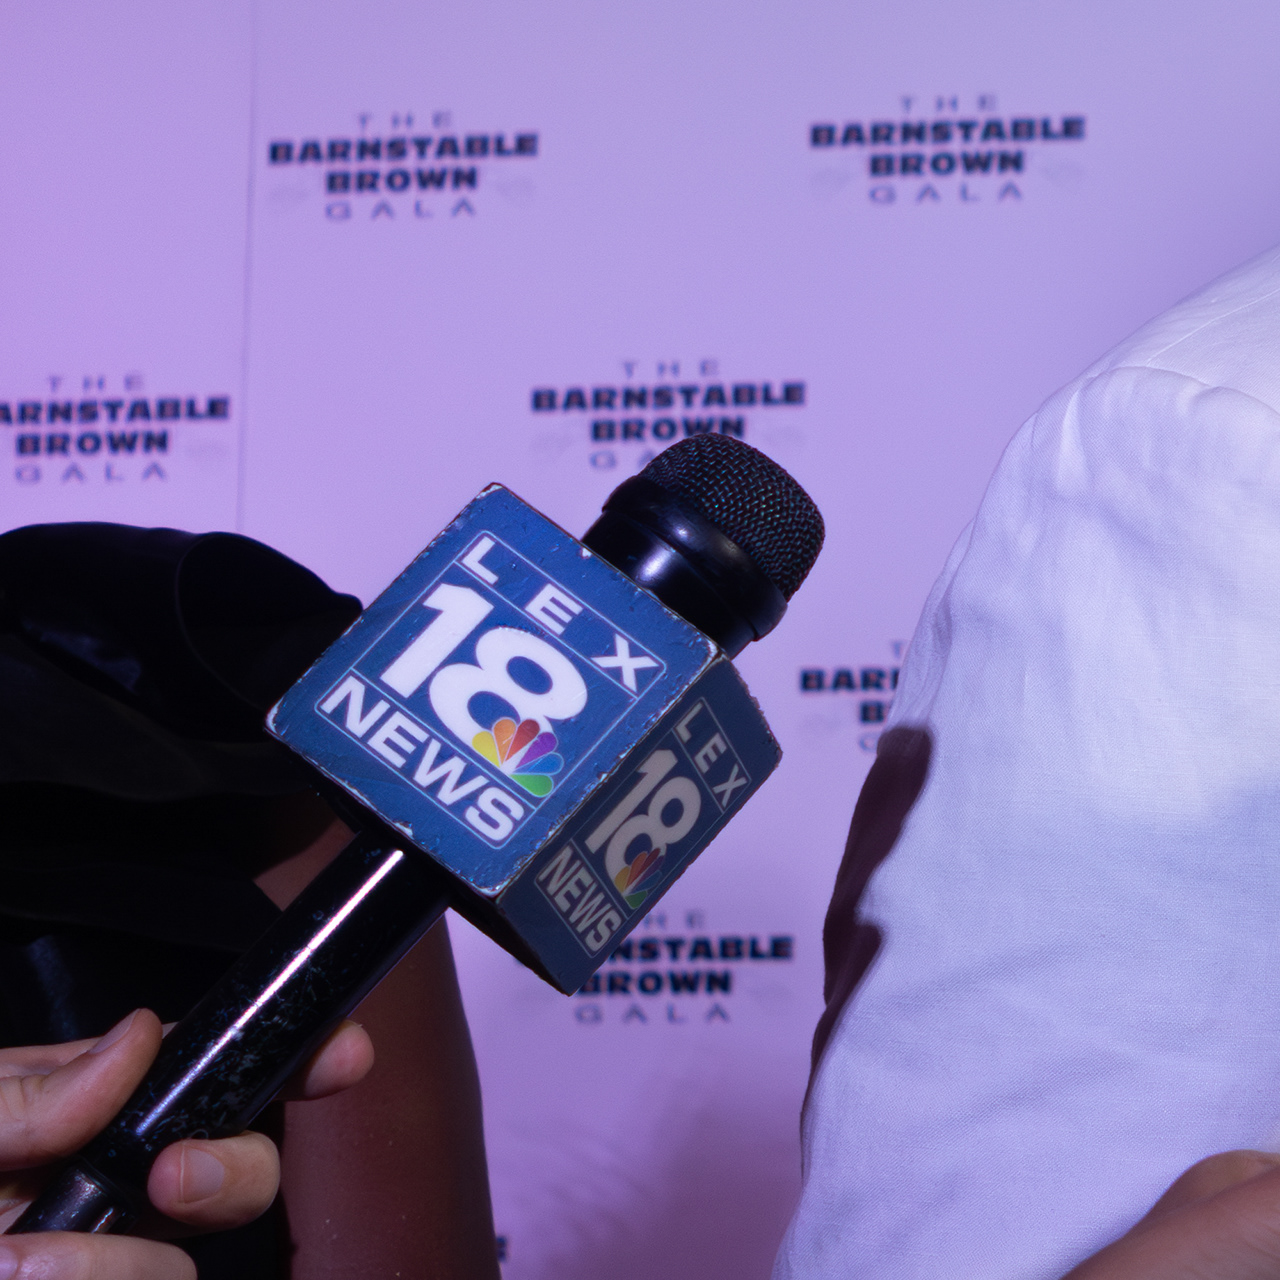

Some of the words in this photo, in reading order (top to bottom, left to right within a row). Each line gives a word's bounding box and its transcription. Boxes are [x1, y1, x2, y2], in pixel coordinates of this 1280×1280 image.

[900, 93, 996, 112] THE
[357, 111, 451, 130] THE
[809, 115, 1086, 149] BARNSTABLE
[268, 132, 539, 166] BARNSTABLE
[869, 150, 1024, 177] BROWN
[326, 166, 478, 194] BROWN
[867, 181, 1022, 204] GALA
[325, 197, 476, 220] GALA
[622, 358, 719, 378] THE
[49, 375, 143, 392] THE
[531, 380, 806, 412] BARNSTABLE
[591, 414, 746, 442] BROWN
[16, 430, 168, 456] BROWN
[15, 462, 167, 483] GALA
[462, 536, 660, 693] LEX
[380, 583, 588, 774] 18
[801, 669, 899, 692] BAR
[319, 675, 525, 841] NEWS
[675, 702, 748, 808] LEX
[584, 749, 702, 898] 18
[537, 845, 623, 953] NEWS
[643, 910, 705, 929] HE
[609, 935, 794, 961] NSTABLE
[577, 970, 731, 995] BROWN
[575, 1002, 729, 1024] GALA
